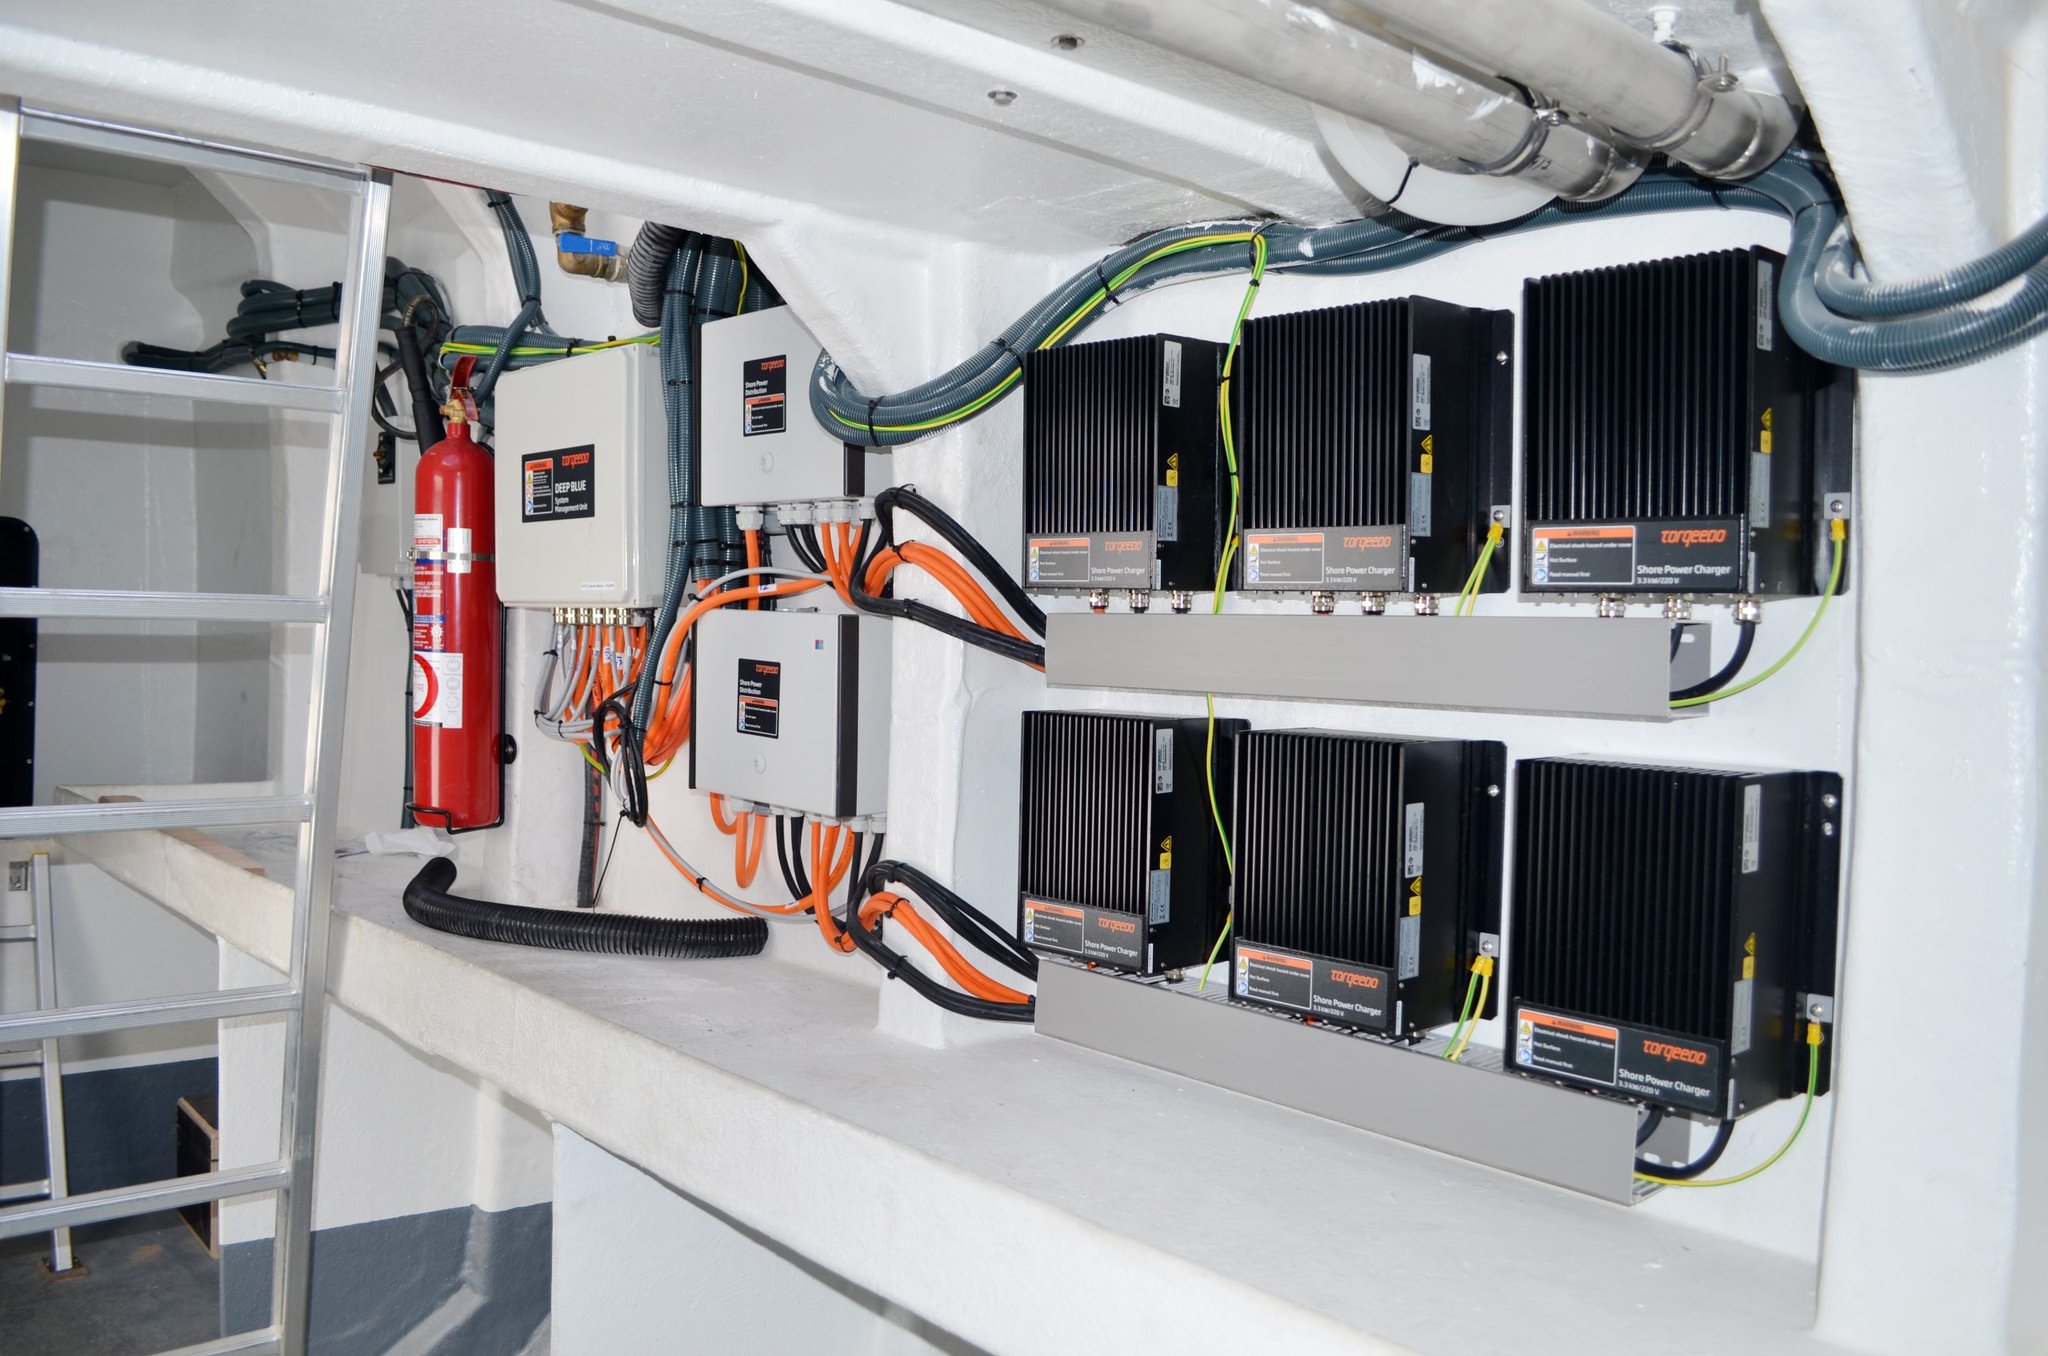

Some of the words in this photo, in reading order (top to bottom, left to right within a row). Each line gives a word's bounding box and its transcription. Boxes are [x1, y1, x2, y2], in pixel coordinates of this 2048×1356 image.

[554, 482, 570, 494] DEEP
[570, 480, 587, 492] BLUE
[555, 504, 579, 514] Management
[1124, 567, 1145, 575] Charger
[1368, 566, 1396, 576] Charger
[1636, 565, 1662, 574] Shore
[1664, 565, 1692, 574] Power
[1694, 565, 1731, 576] Charger
[1084, 940, 1100, 950] Shore
[1100, 943, 1116, 953] Power
[1117, 946, 1138, 957] Charger
[1313, 994, 1332, 1006] Shore
[1333, 999, 1354, 1010] Power
[1354, 1004, 1382, 1017] Charger
[1618, 1068, 1645, 1082] Shore
[1646, 1074, 1674, 1088] Power
[1675, 1081, 1711, 1097] Charger
[1618, 1080, 1628, 1088] 3.3
